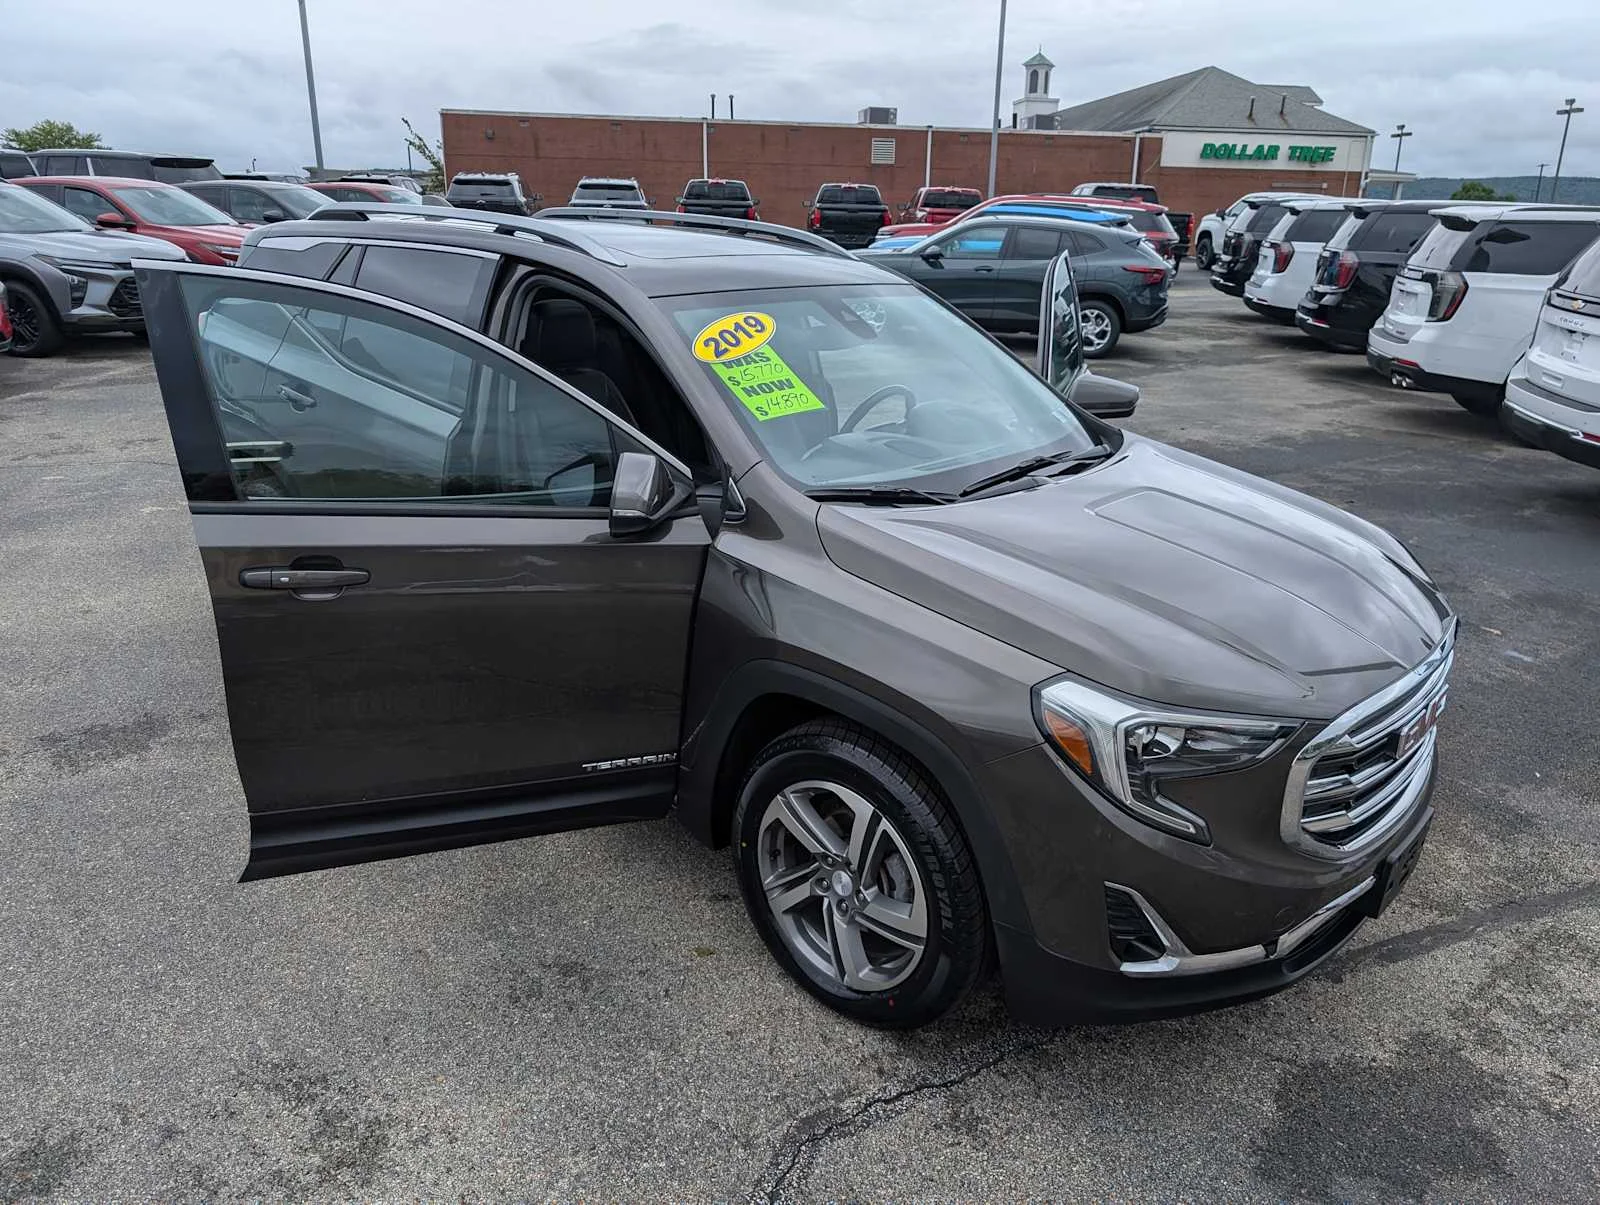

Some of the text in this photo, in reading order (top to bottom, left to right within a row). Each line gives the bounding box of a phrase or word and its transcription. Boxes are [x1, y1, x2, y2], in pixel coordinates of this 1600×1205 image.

[1200, 143, 1336, 162] DOLLAR TREE
[703, 315, 766, 359] 2019
[722, 351, 771, 369] WAS
[741, 378, 795, 397] NOW
[582, 752, 677, 772] TERRAIN
